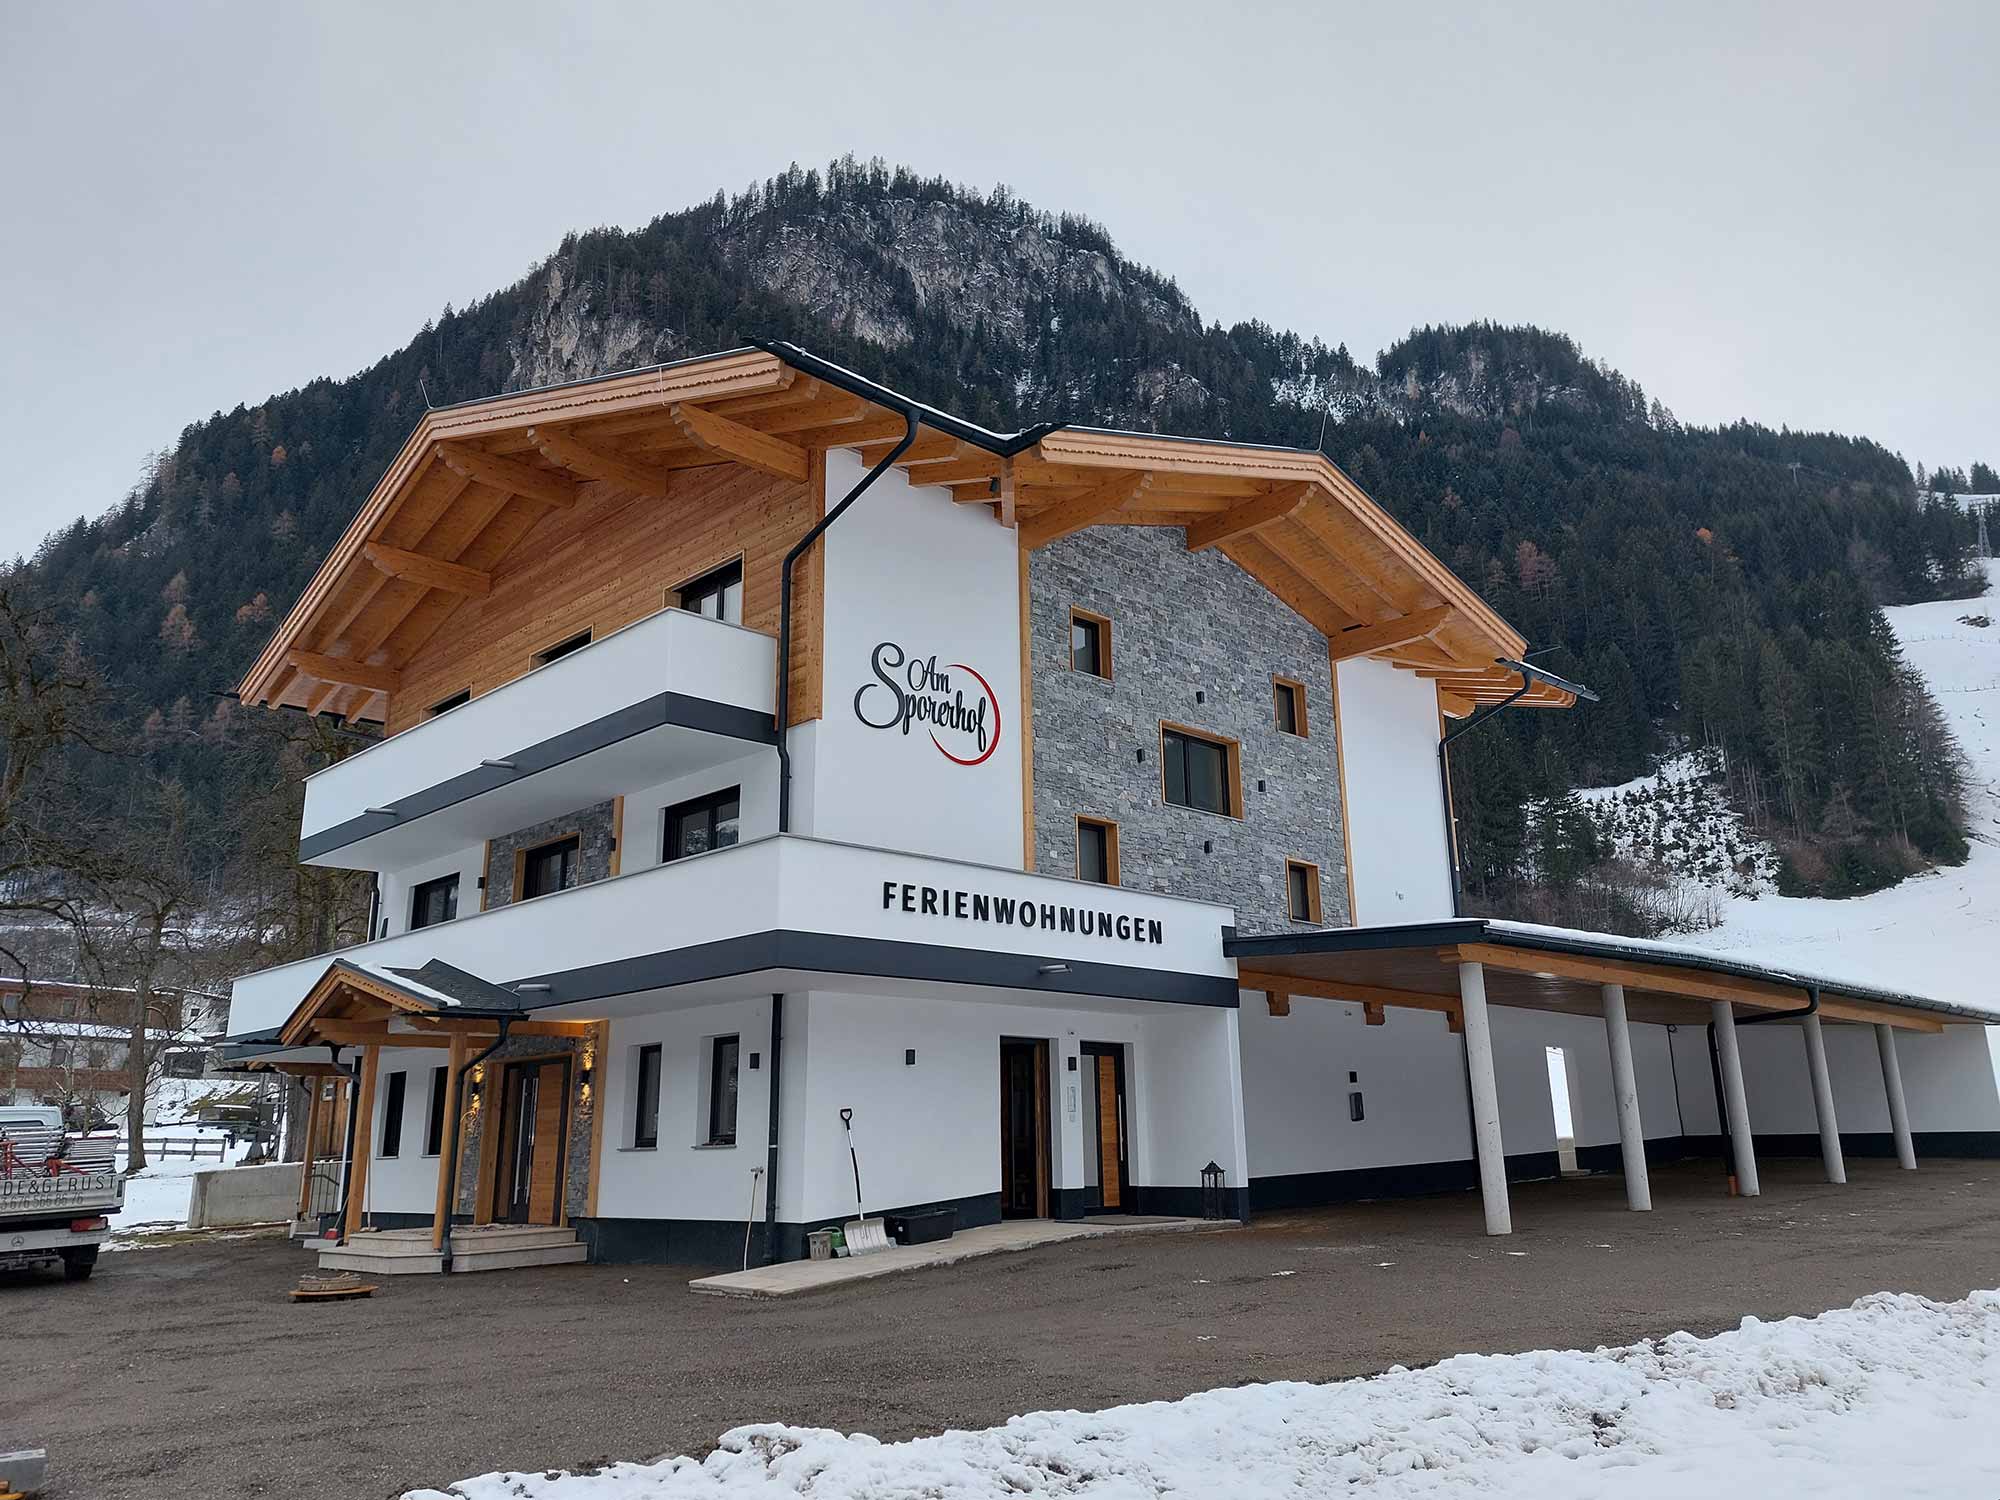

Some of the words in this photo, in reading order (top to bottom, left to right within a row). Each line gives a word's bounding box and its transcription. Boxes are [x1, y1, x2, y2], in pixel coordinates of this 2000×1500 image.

[854, 642, 986, 752] Sporerhof
[907, 655, 951, 694] Am
[883, 881, 1163, 945] FERIENWOHNUNGEN
